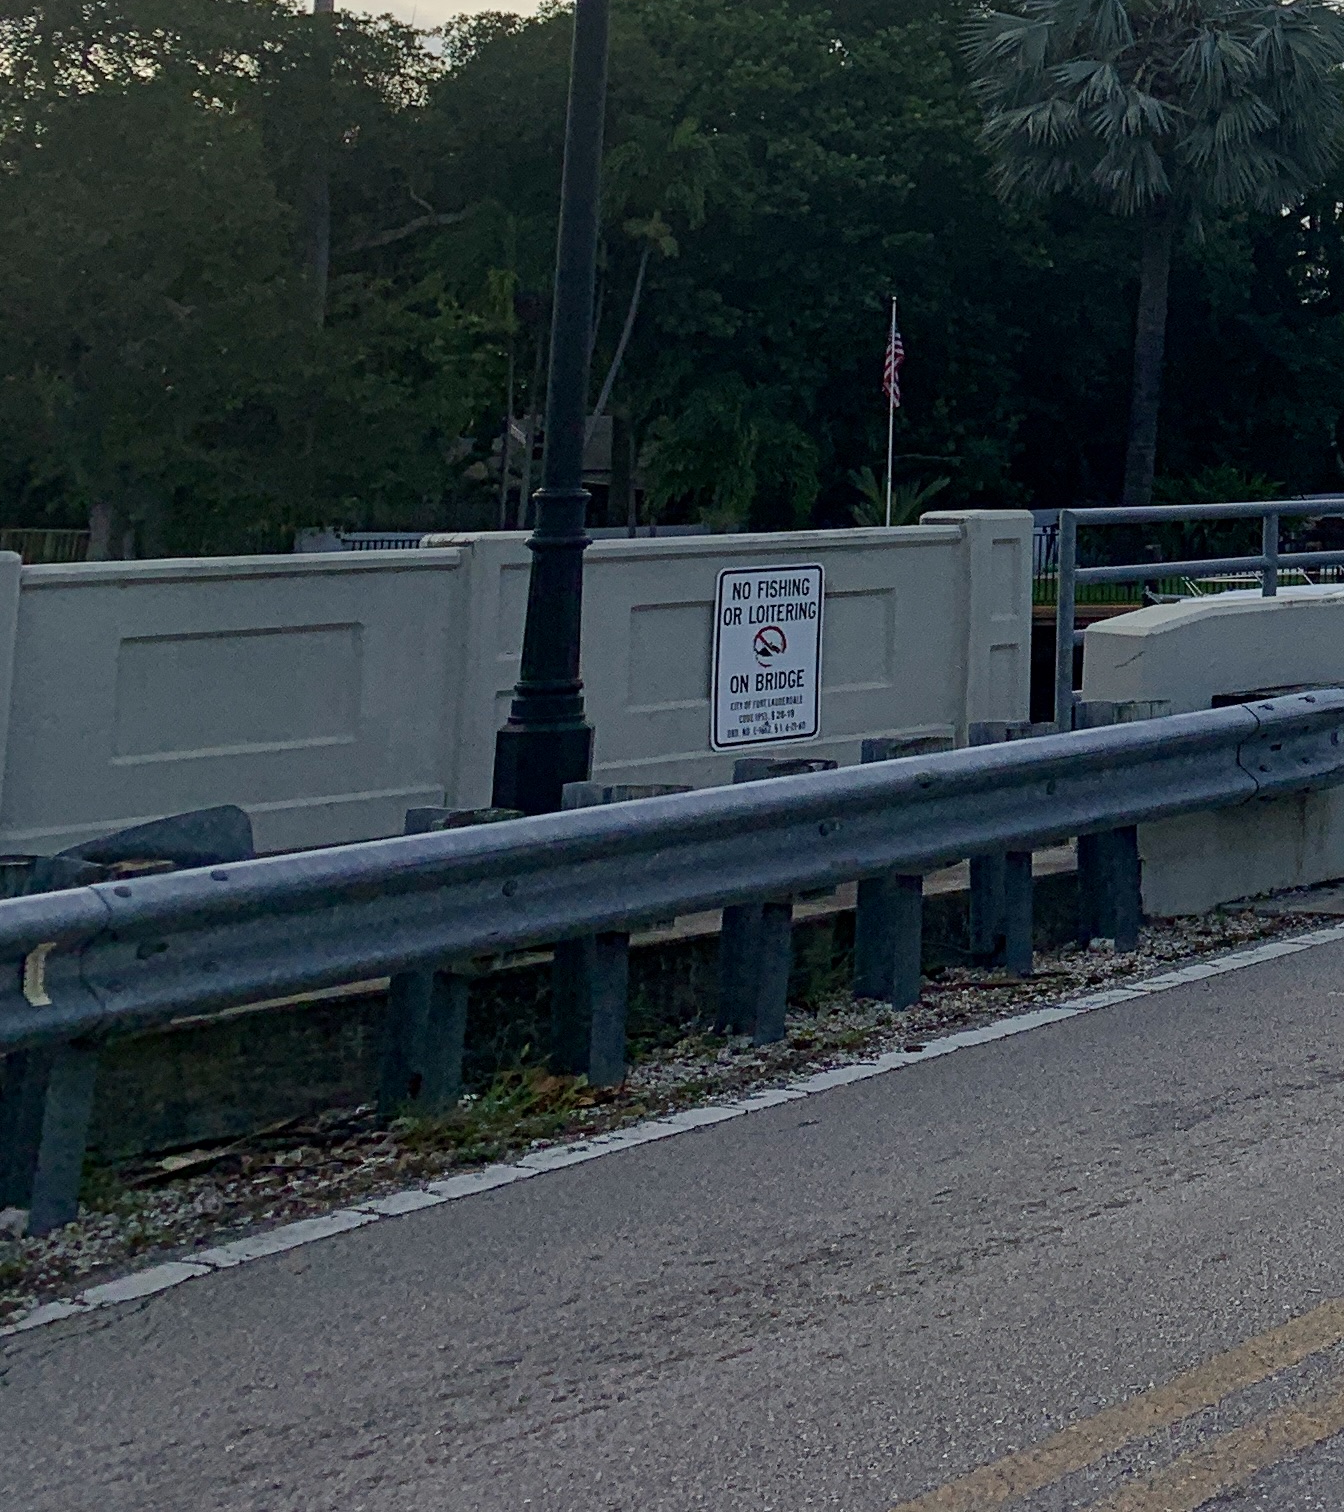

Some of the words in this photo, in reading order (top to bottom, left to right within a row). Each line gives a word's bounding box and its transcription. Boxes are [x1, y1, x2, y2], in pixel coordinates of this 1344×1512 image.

[732, 581, 751, 601] NO
[757, 577, 811, 599] FISHING
[723, 606, 743, 626] OR
[748, 601, 817, 625] LOITERING
[730, 674, 749, 694] ON
[755, 668, 805, 692] BRIDGE
